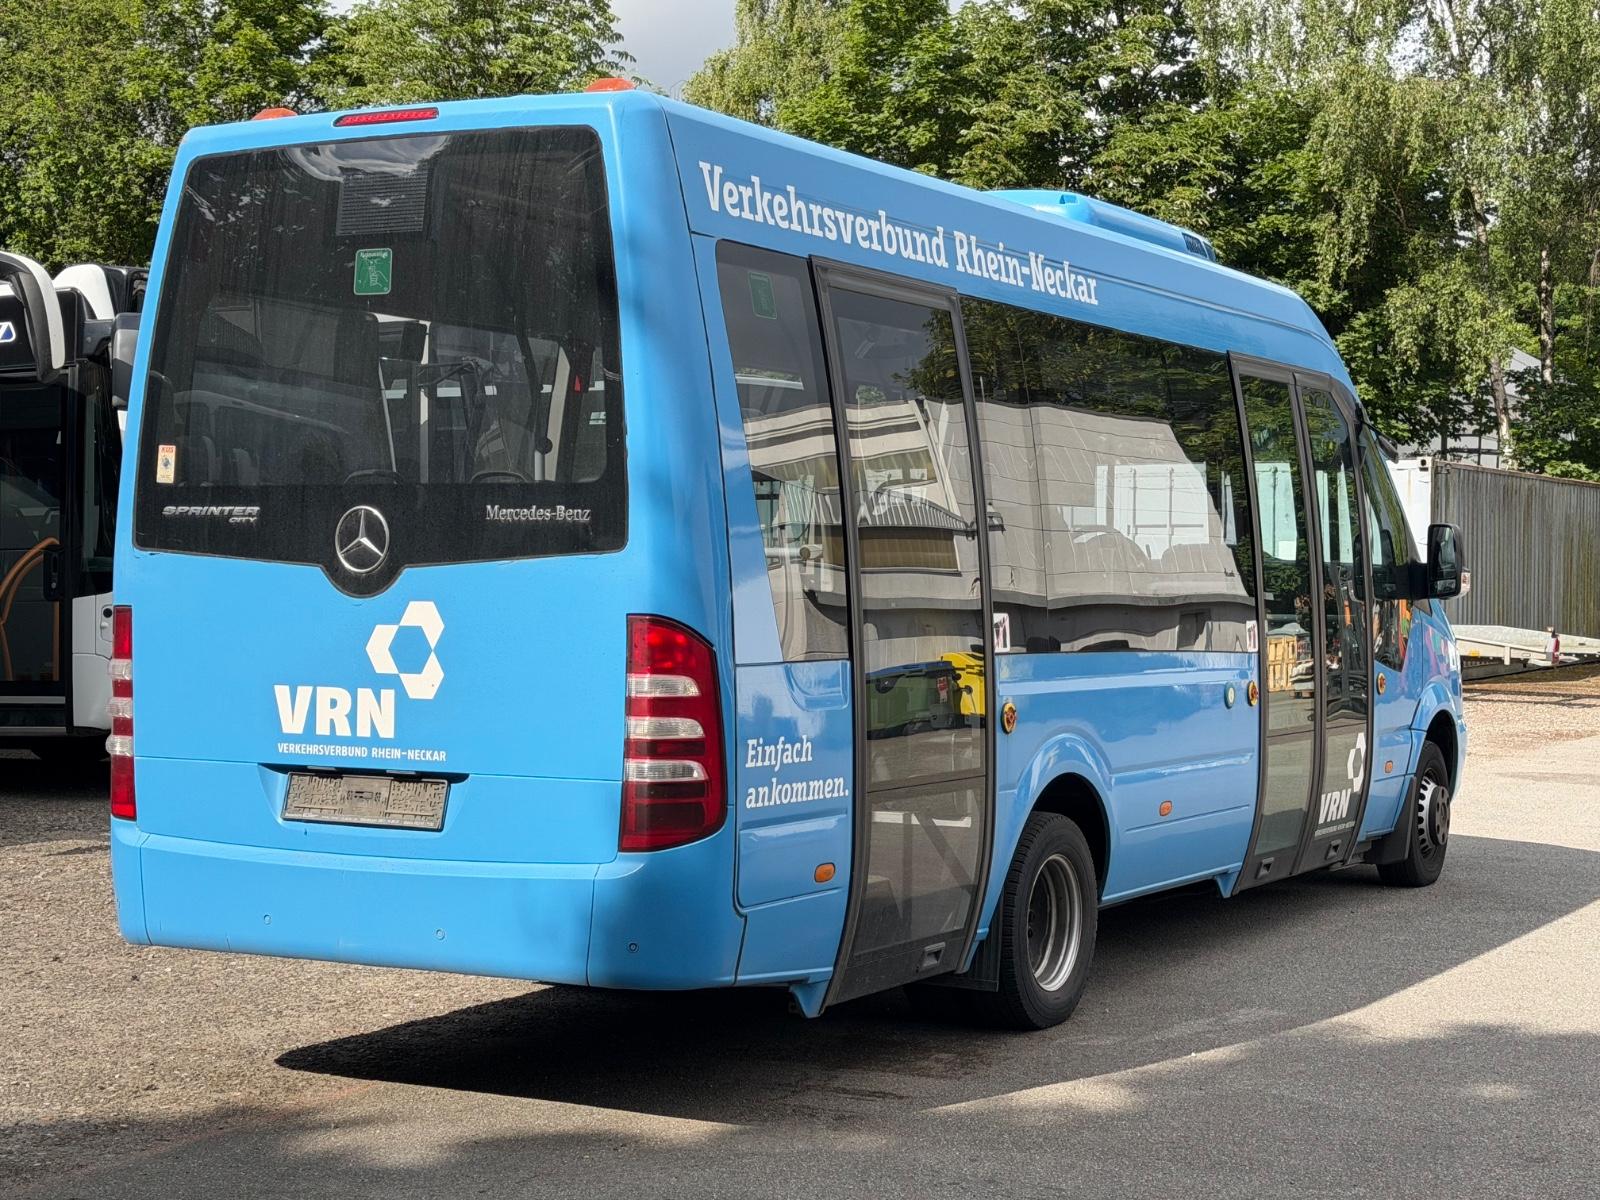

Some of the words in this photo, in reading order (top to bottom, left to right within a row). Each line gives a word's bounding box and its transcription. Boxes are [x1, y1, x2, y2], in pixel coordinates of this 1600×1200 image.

[699, 160, 949, 269] Verkehrsverbund
[953, 230, 1099, 306] Rhein-Neckar
[162, 506, 260, 516] SPRINTER
[485, 504, 591, 521] Mercedes-Benz
[273, 685, 395, 739] VRN
[277, 742, 368, 758] VERKEHRSVERBUND
[371, 746, 447, 761] RHEIN-NECKAR
[745, 734, 813, 772] Einfach
[745, 776, 849, 809] ankommen.
[1318, 788, 1352, 825] VRN
